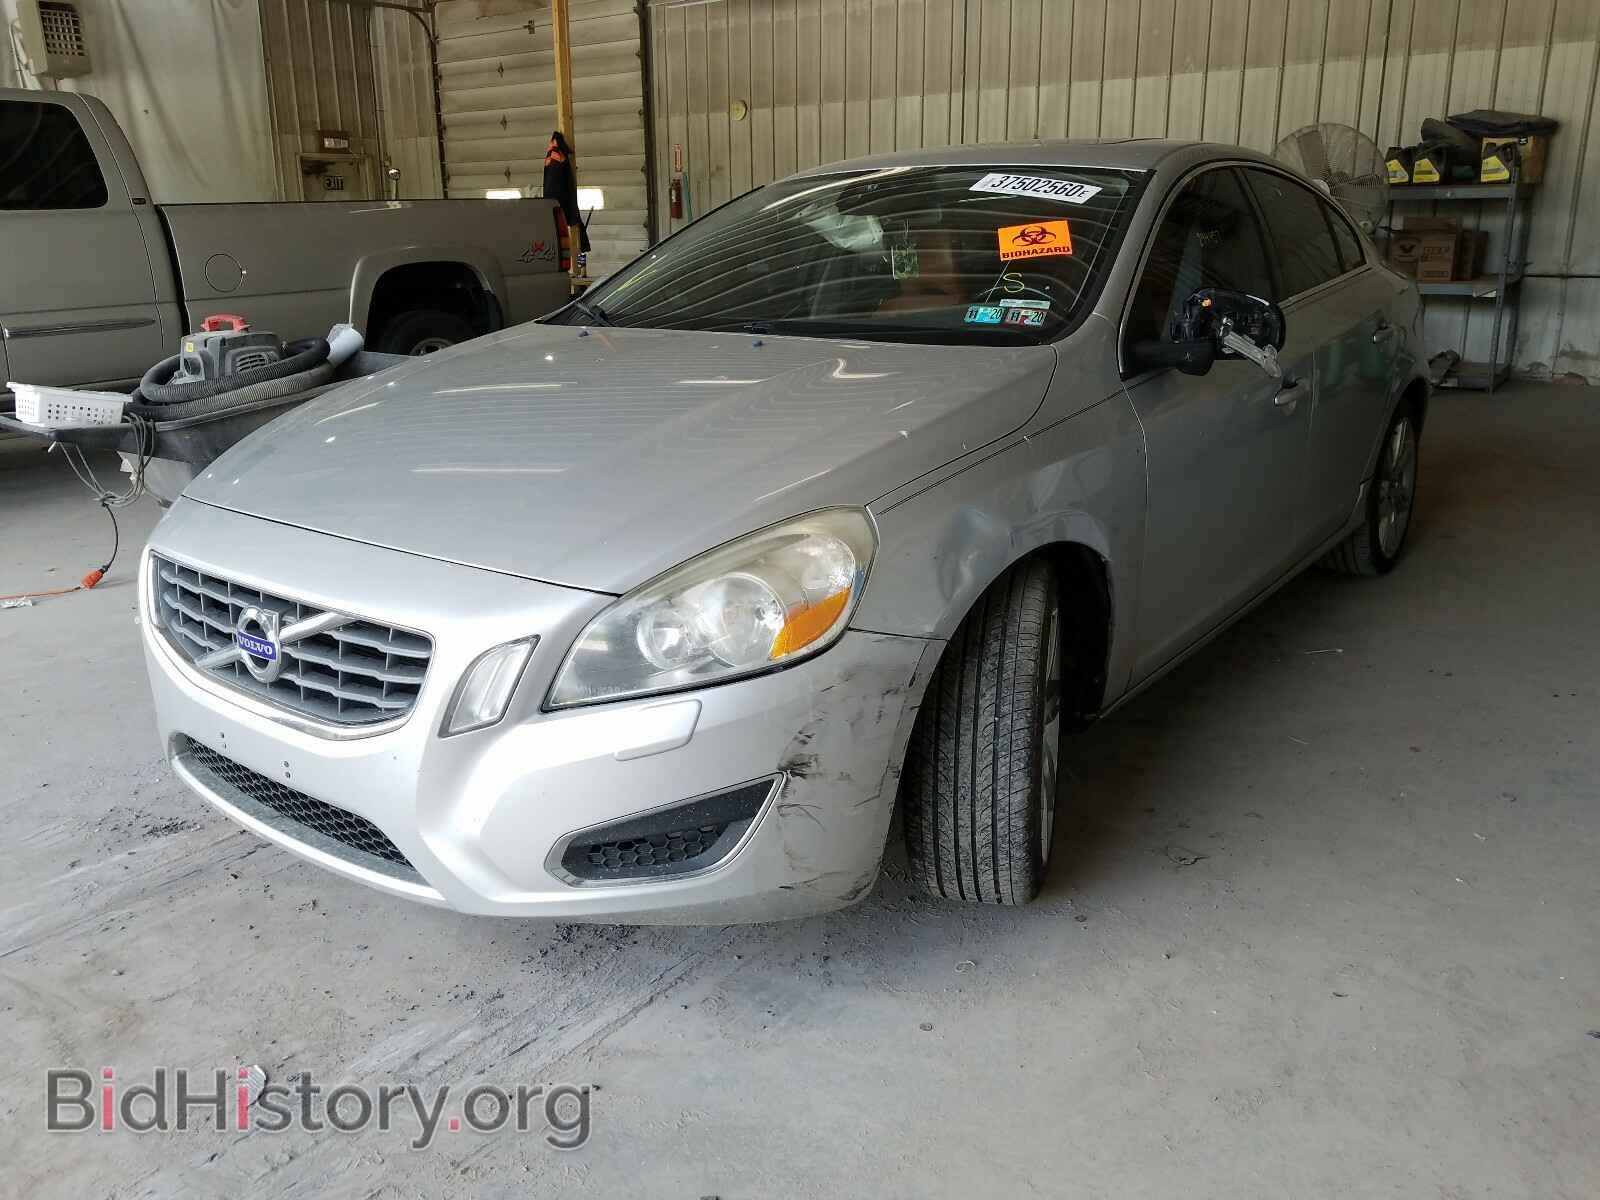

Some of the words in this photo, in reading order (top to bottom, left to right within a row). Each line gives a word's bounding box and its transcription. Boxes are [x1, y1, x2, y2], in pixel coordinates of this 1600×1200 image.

[1002, 246, 1071, 259] BIOHAZARD
[1003, 272, 1025, 293] S
[991, 308, 1003, 320] 20
[1031, 311, 1044, 323] 20
[238, 635, 273, 655] VOLVO
